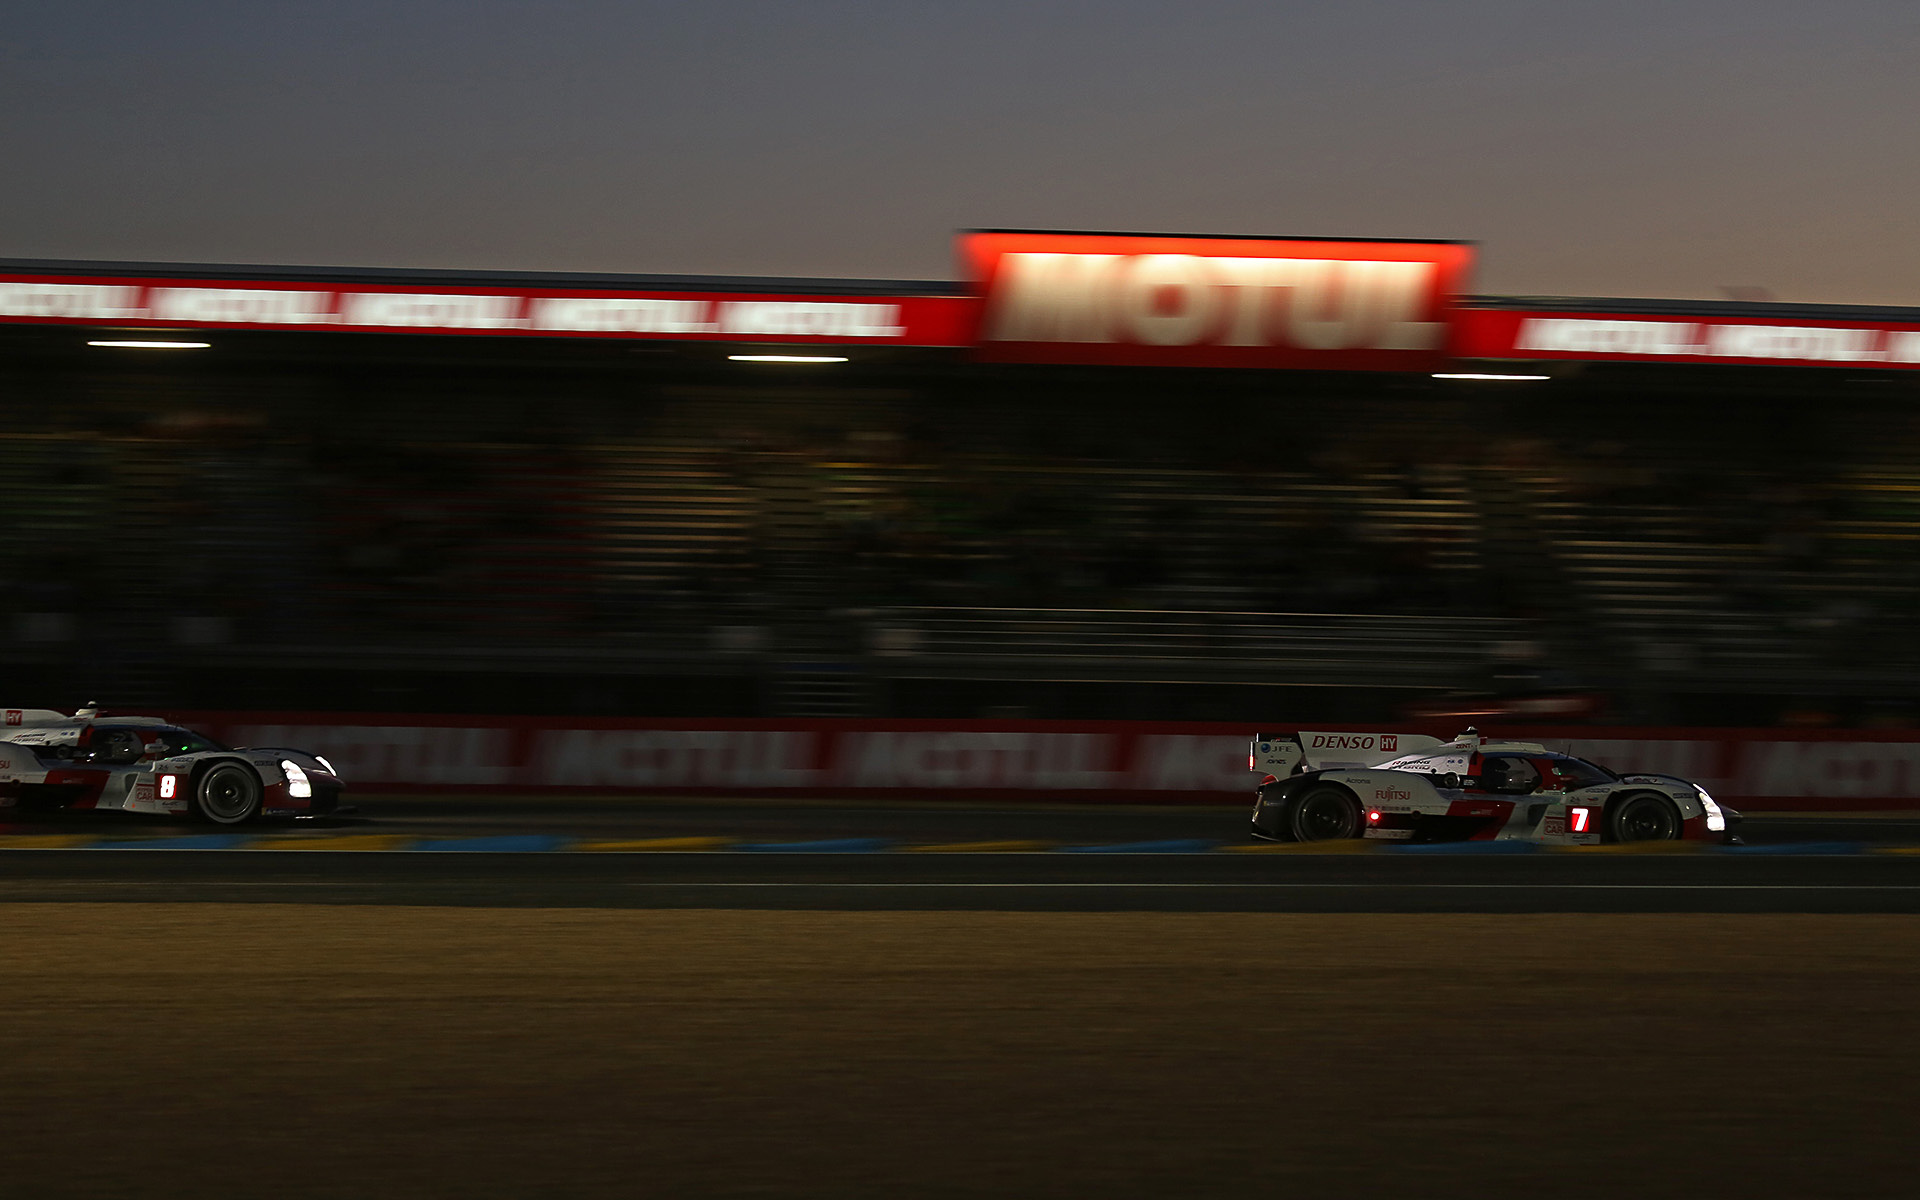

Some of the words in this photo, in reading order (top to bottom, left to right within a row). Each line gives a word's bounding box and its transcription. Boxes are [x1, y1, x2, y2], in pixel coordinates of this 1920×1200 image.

[983, 252, 1449, 351] MOTUL
[1312, 735, 1375, 750] DENSO
[1381, 738, 1397, 750] HY
[160, 775, 176, 798] 8
[1376, 788, 1411, 801] FUJITSU
[1546, 825, 1564, 833] CAR
[1571, 808, 1589, 831] 7
